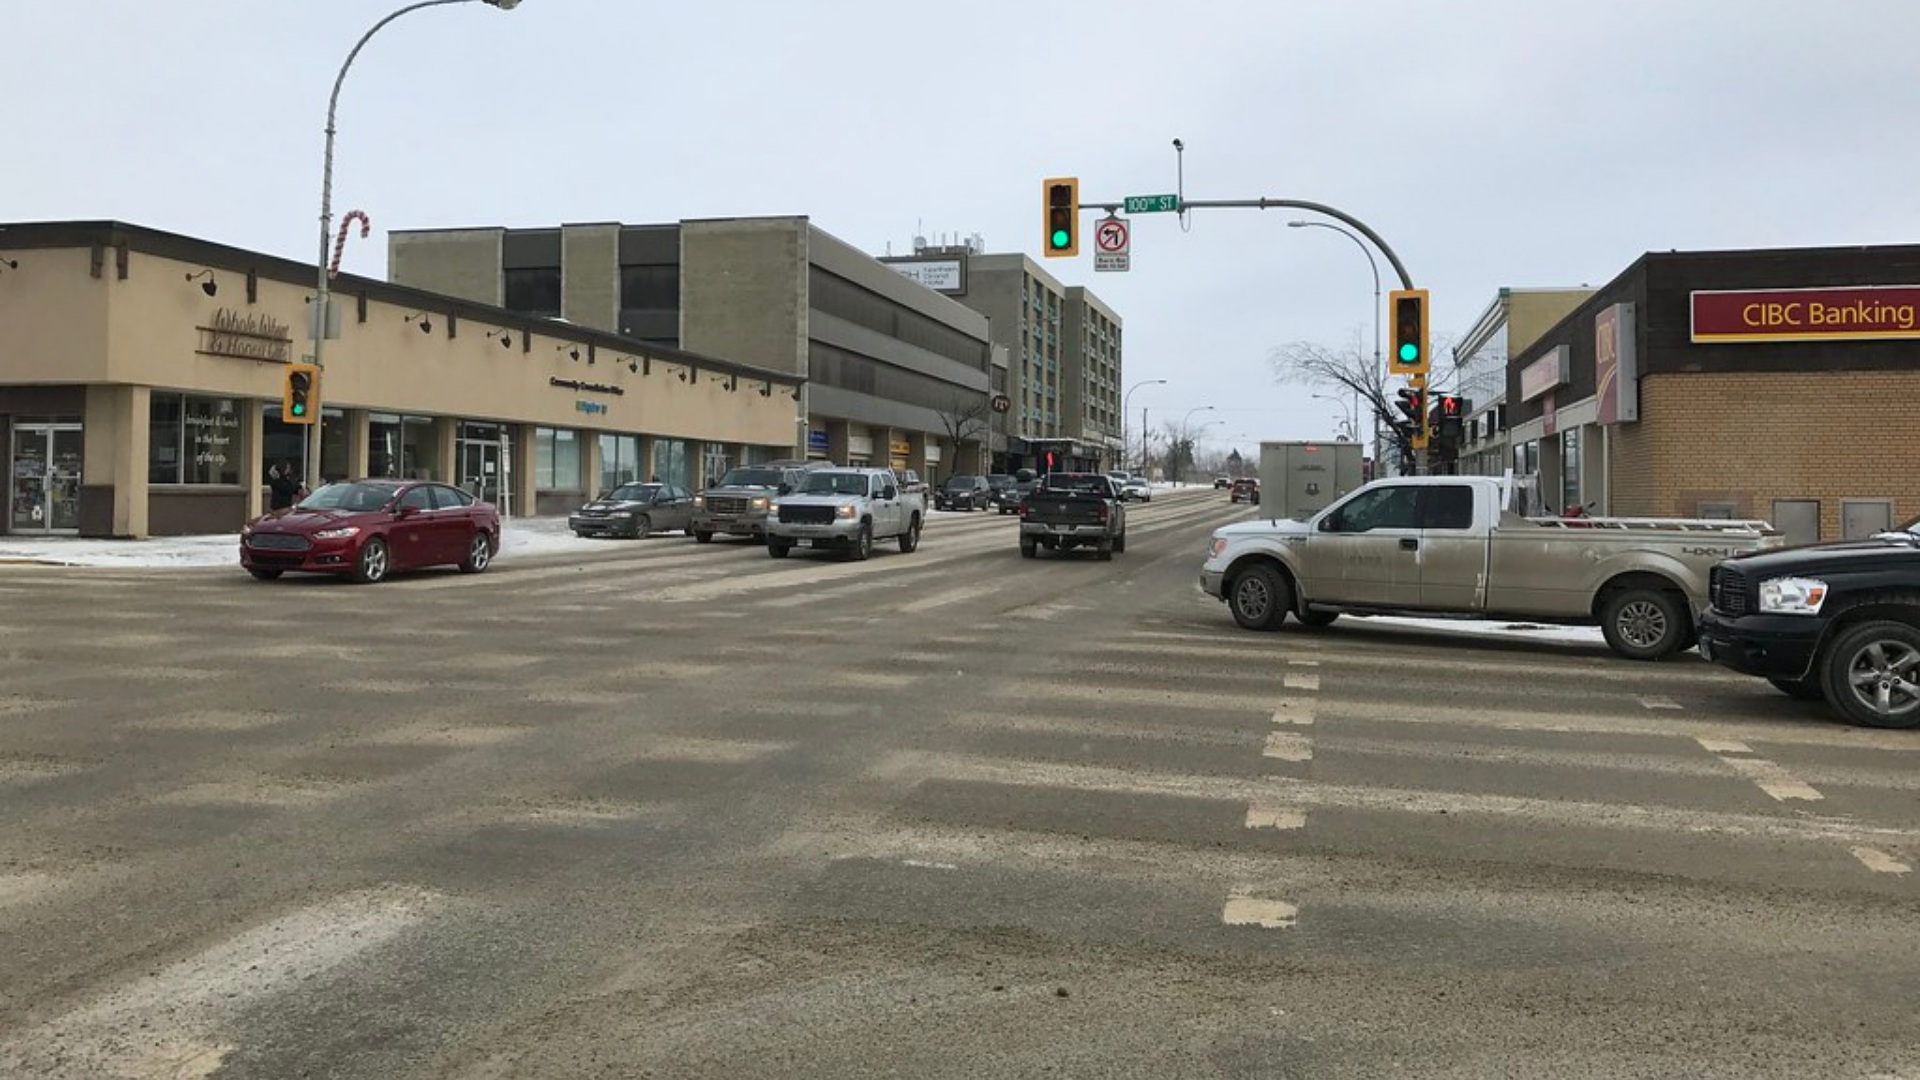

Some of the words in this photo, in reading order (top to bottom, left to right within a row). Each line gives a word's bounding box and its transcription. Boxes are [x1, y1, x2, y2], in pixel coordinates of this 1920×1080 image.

[1160, 196, 1173, 210] ST
[1743, 303, 1801, 326] CIBC
[1809, 299, 1914, 328] Banking
